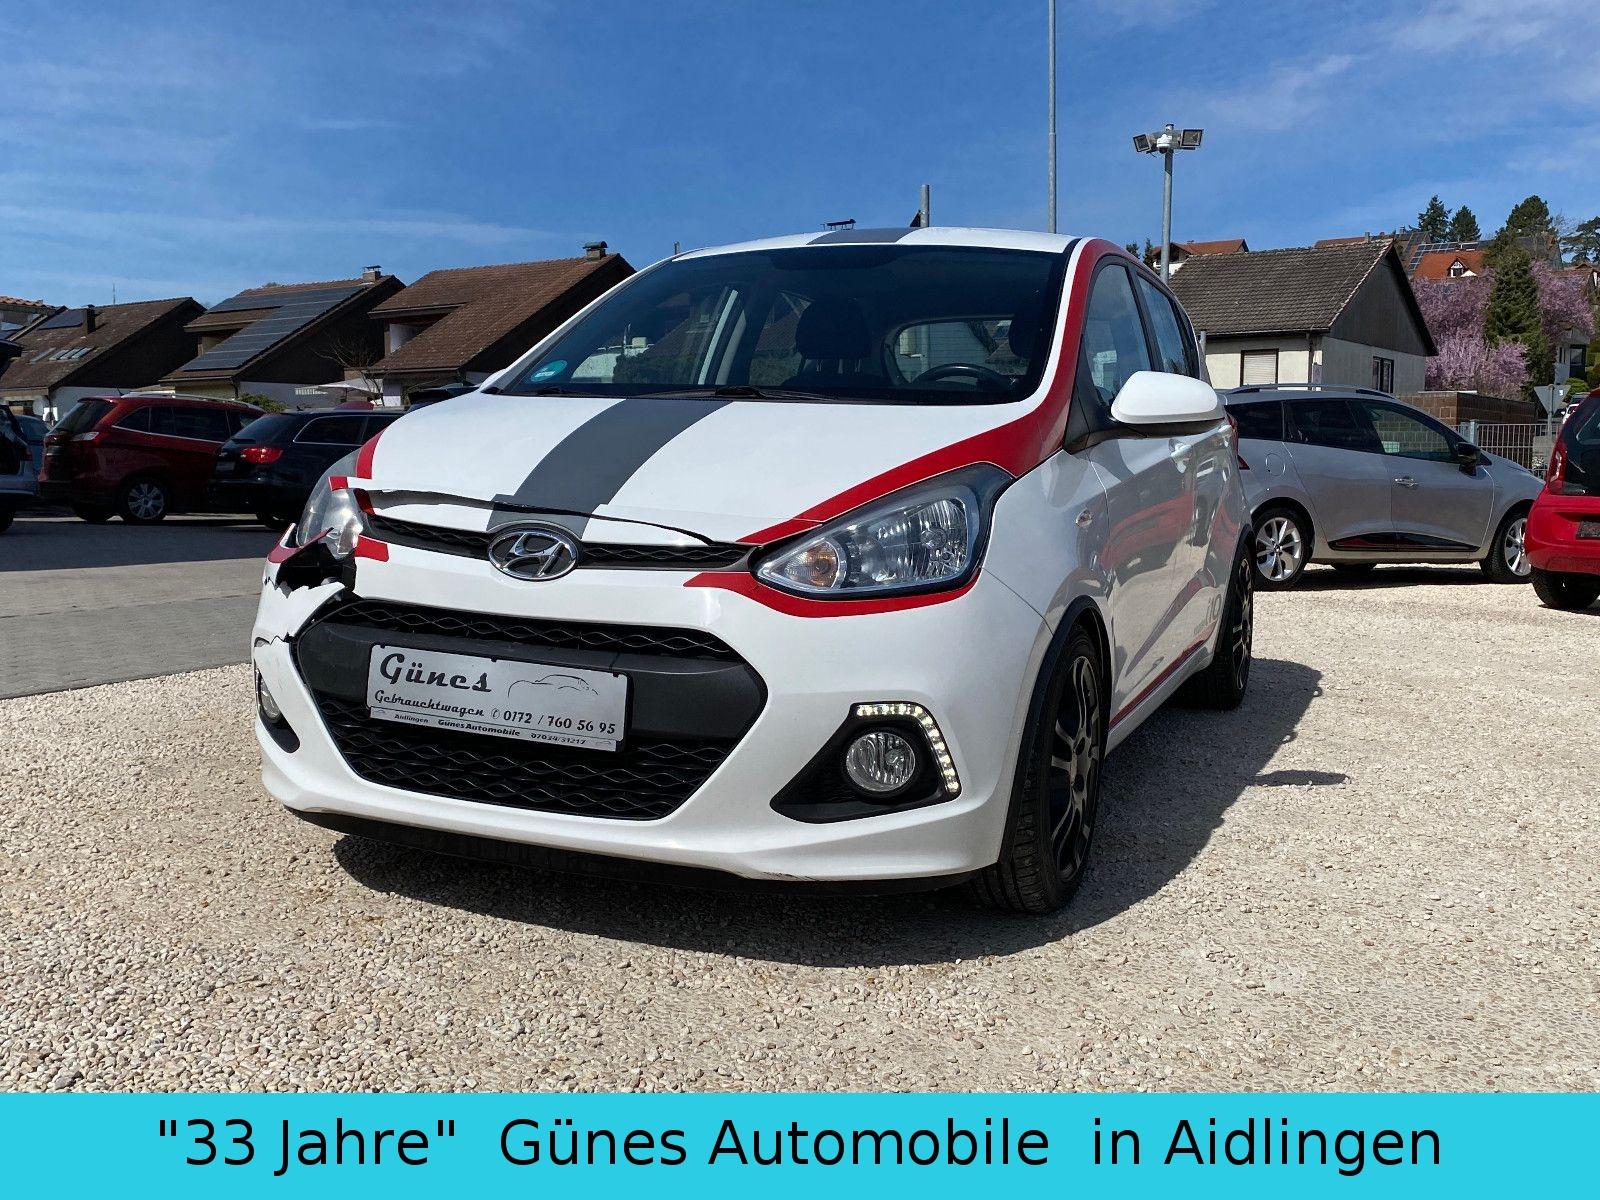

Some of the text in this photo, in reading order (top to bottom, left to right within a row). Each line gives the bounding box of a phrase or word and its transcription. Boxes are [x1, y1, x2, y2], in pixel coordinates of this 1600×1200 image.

[380, 653, 492, 693] Günes
[374, 689, 485, 718] Gebrauchtwagen
[503, 710, 533, 724] 0172
[547, 715, 572, 729] 760
[577, 719, 594, 732] 56
[599, 722, 616, 735] 95
[394, 713, 430, 723] Aidlingen
